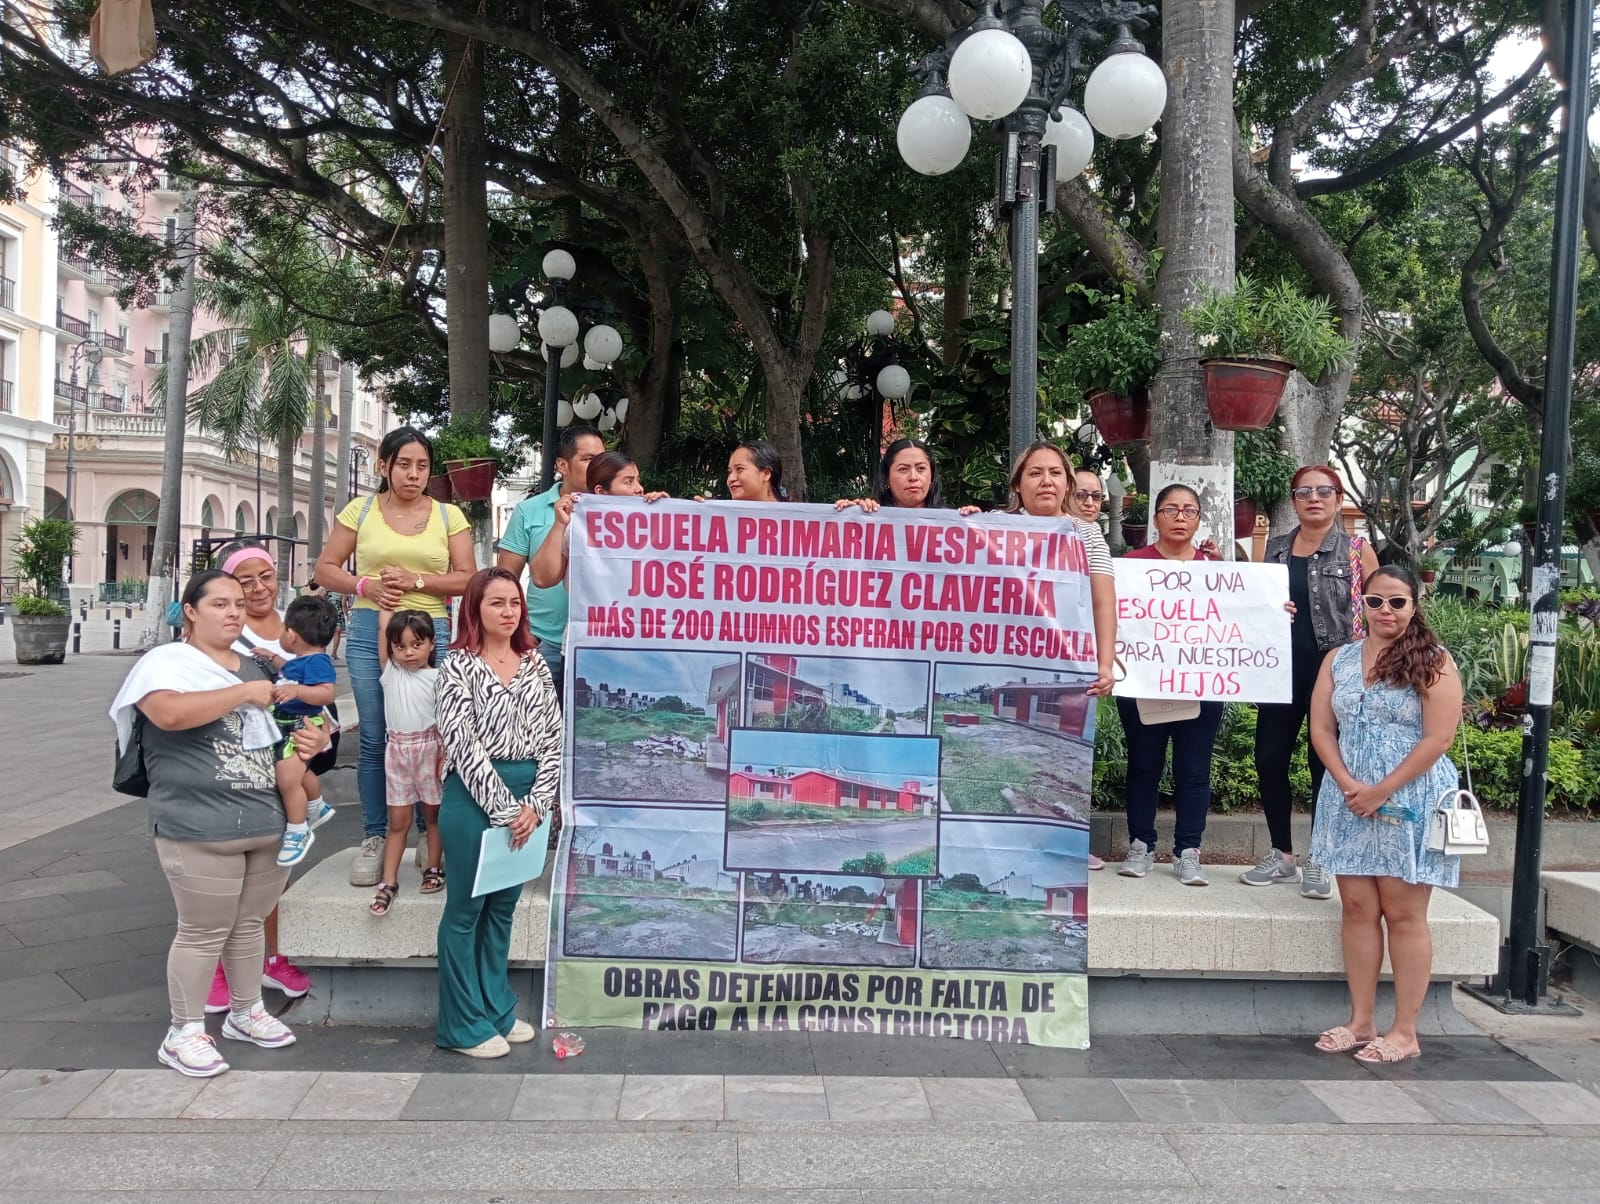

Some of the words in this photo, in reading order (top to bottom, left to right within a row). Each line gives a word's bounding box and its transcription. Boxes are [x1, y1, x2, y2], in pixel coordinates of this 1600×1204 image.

[586, 511, 728, 553] ESCUELA
[737, 517, 896, 561] PRIMARIA
[628, 556, 705, 600] JOSÉ
[713, 561, 894, 609] RODRÍGUEZ
[900, 571, 1057, 618] CLAVERÍA
[1145, 568, 1192, 593] POR
[1205, 571, 1245, 593] UNA
[1118, 597, 1222, 622] ESCUELA
[587, 601, 635, 639] MÁS
[640, 608, 666, 639] DE
[671, 609, 714, 641] 200
[719, 611, 820, 646] ALUMNOS
[825, 616, 915, 650] ESPERAN
[921, 620, 964, 653] POR
[969, 623, 998, 655] SU
[1003, 624, 1097, 663] ESCUELA
[1153, 622, 1244, 645] DIGNA
[1115, 640, 1165, 664] PARA
[1178, 646, 1280, 669] NUESTROS
[1159, 668, 1241, 697] HIJOS
[604, 966, 700, 1000] OBRAS
[708, 970, 860, 1003] DETENIDAS
[866, 974, 923, 1006] POR
[930, 978, 1008, 1012] FALTA
[1021, 982, 1056, 1013] DE
[642, 1001, 717, 1031] PAGO
[730, 1006, 750, 1031] A
[757, 1004, 790, 1032] LA
[797, 1004, 1030, 1044] CONSTRUCTORA
